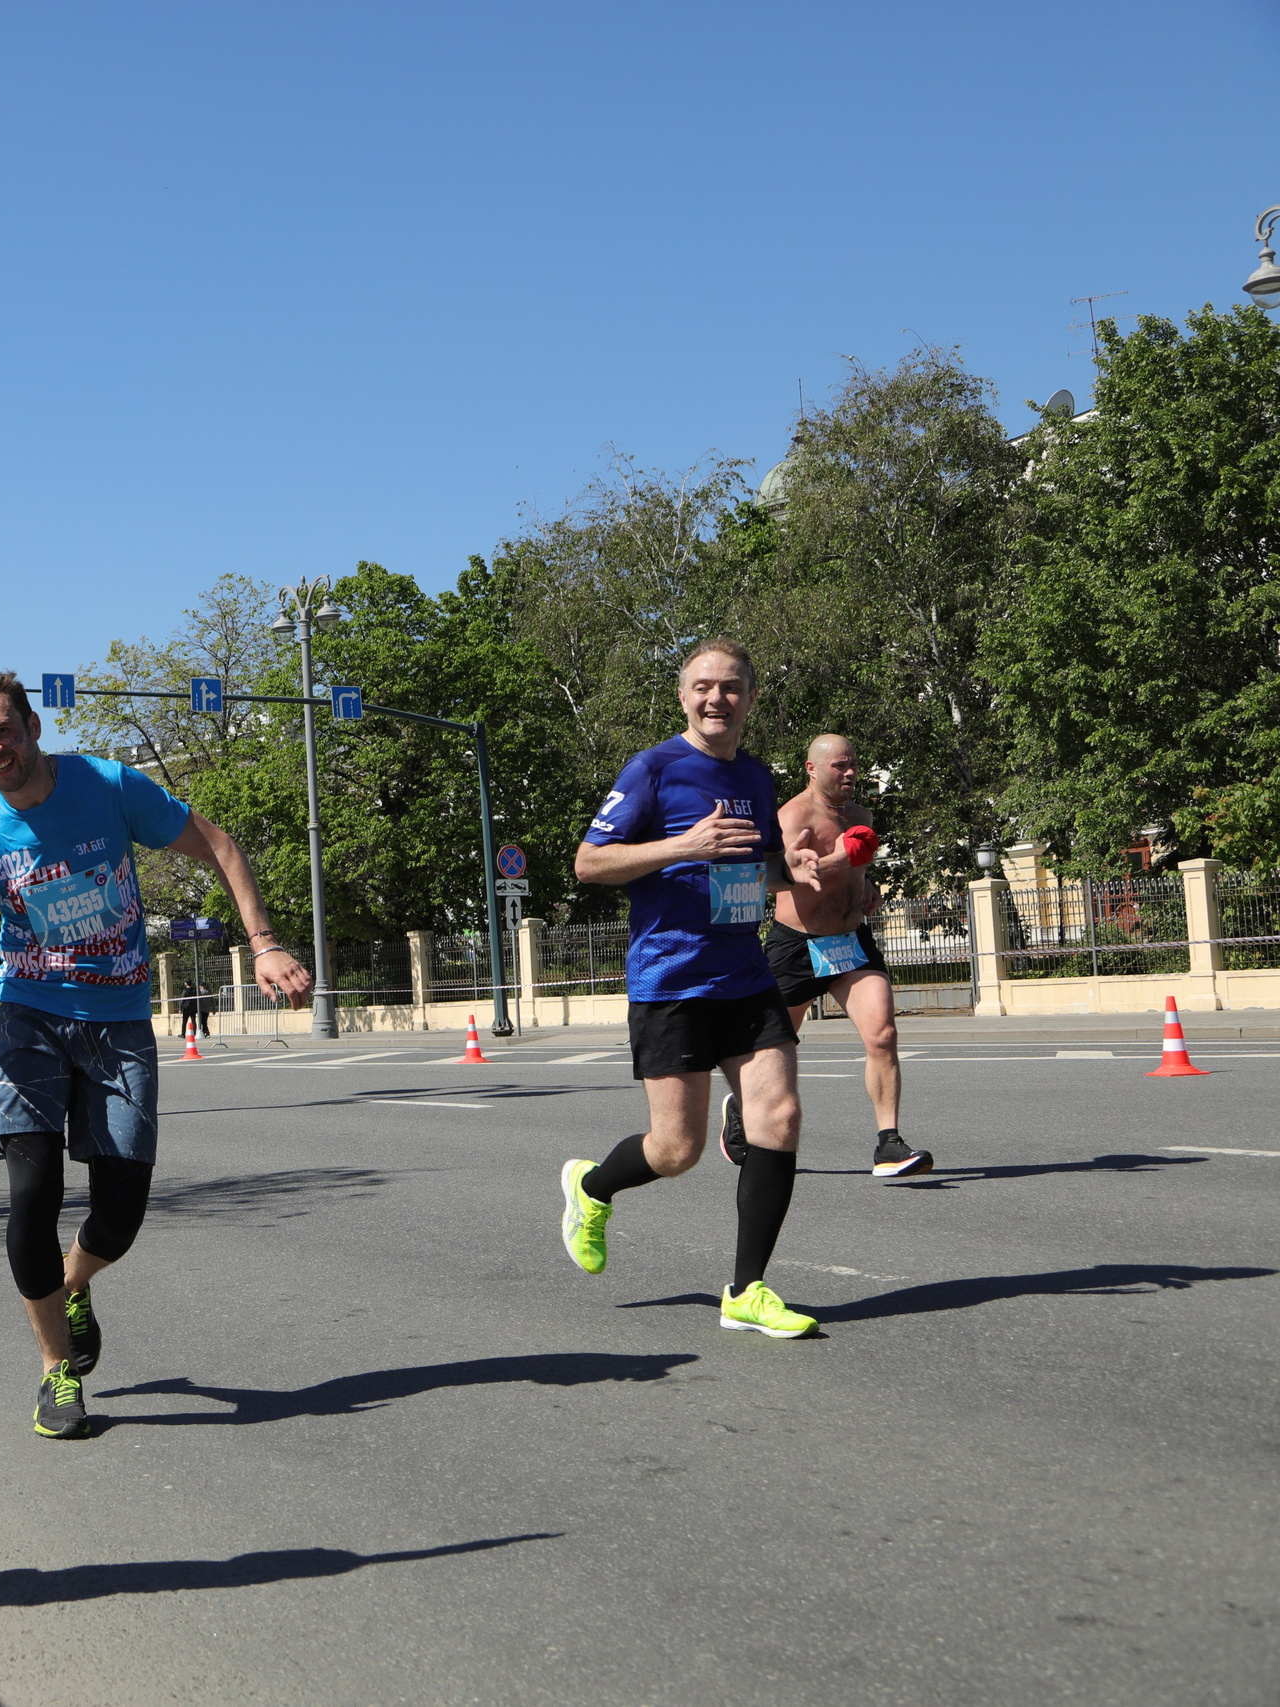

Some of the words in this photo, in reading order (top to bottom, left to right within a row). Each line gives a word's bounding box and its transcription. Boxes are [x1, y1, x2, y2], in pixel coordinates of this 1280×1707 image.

[590, 818, 615, 832] 023
[723, 881, 761, 904] 40806
[47, 888, 105, 925] 43255
[822, 945, 854, 963] 43935
